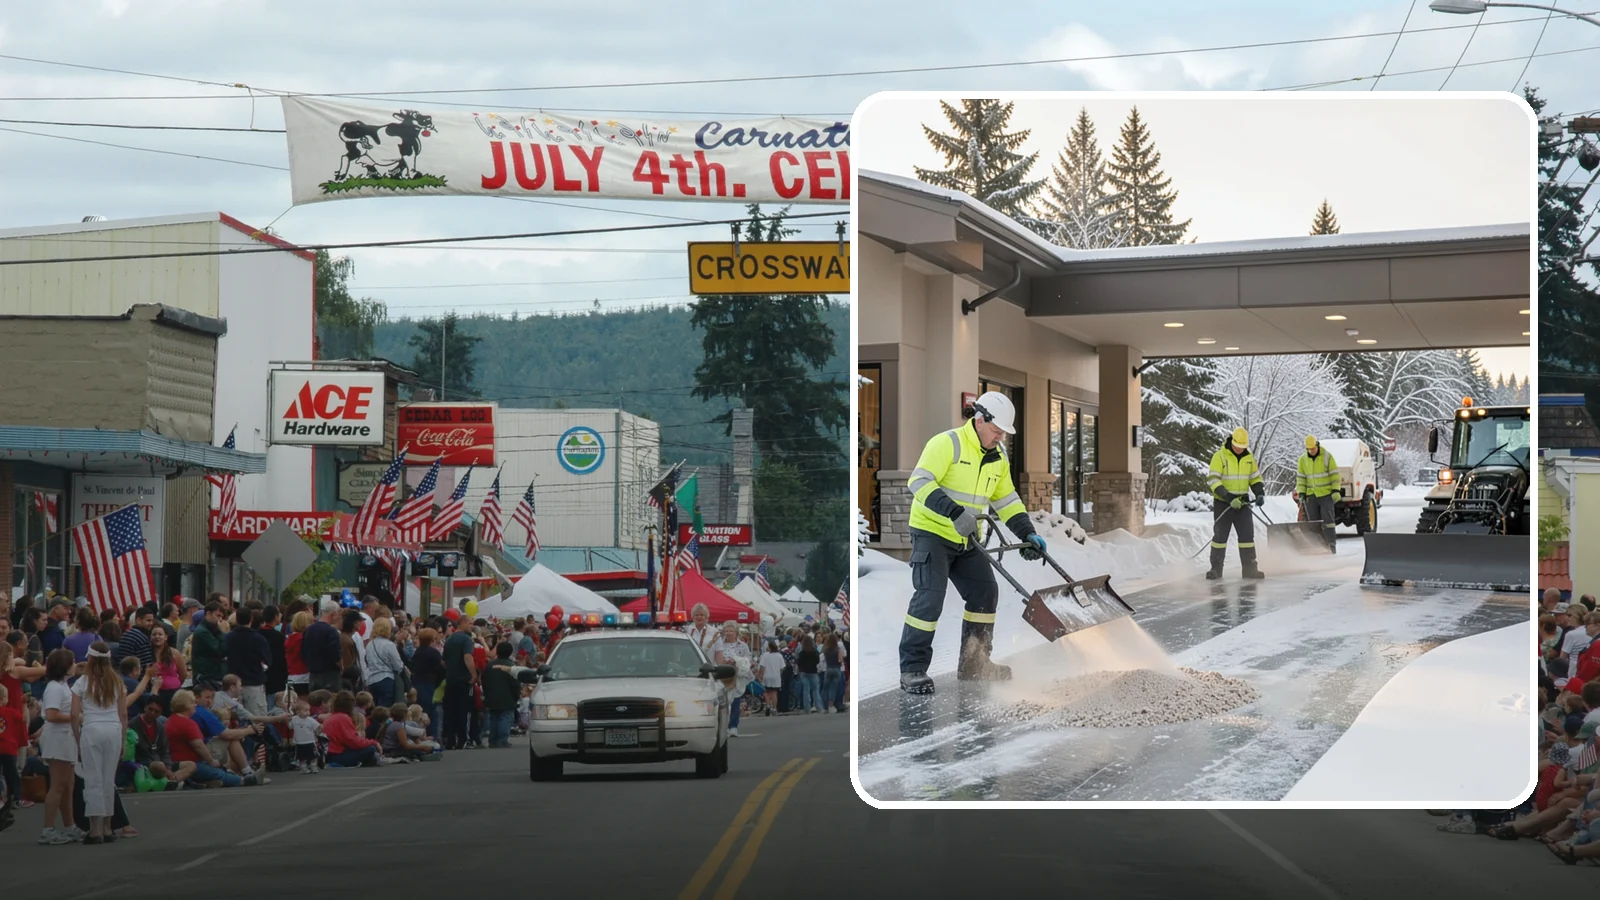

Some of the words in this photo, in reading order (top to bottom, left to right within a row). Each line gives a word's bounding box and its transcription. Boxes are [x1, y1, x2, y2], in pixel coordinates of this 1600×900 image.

[481, 141, 605, 192] JULY
[632, 150, 746, 198] 4th.
[697, 254, 850, 279] CROSSWA
[282, 380, 373, 420] ACE
[405, 409, 452, 422] CEDAR
[283, 421, 371, 437] Hardware
[416, 428, 477, 446] Coca-Cola
[83, 486, 93, 495] St.
[96, 485, 124, 495] Vincent
[126, 486, 136, 495] de
[138, 485, 155, 496] Paul
[81, 503, 153, 522] THT
[212, 515, 330, 536] HARDARE
[688, 526, 741, 535] CRNATION
[699, 535, 730, 543] GLASS
